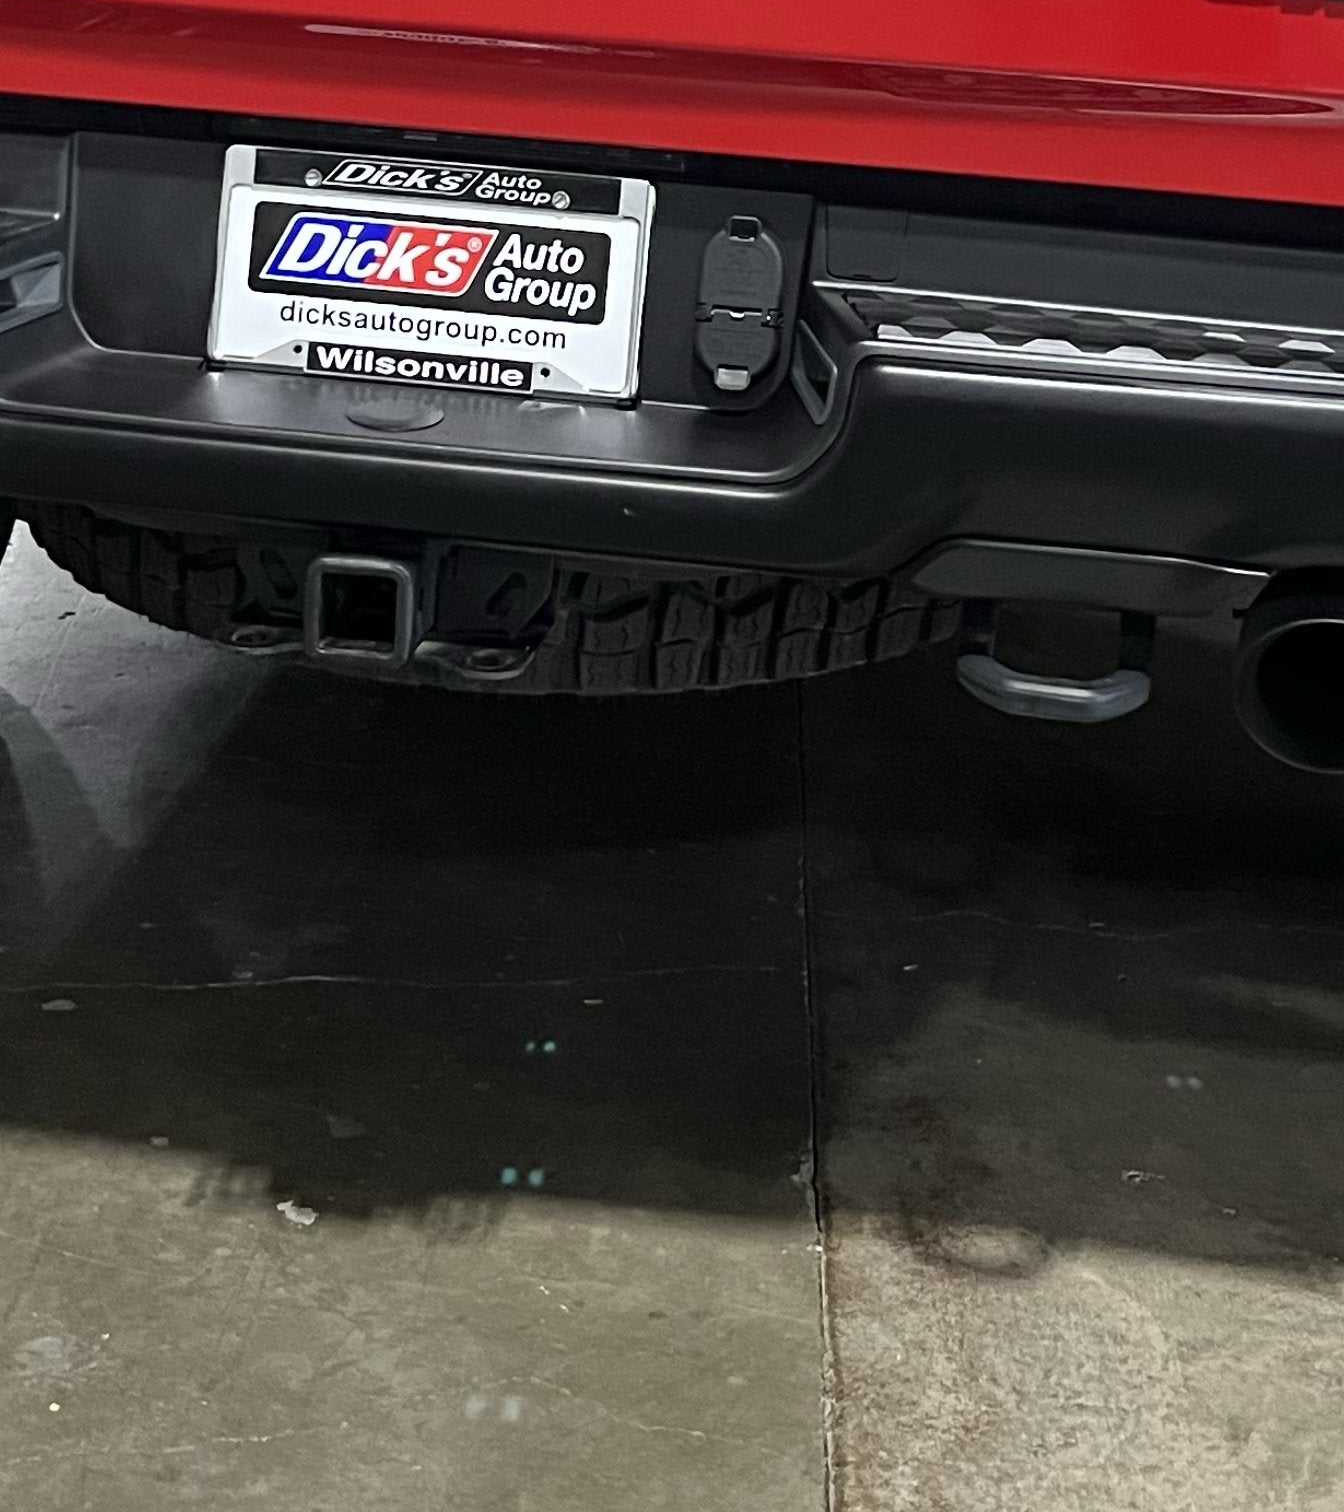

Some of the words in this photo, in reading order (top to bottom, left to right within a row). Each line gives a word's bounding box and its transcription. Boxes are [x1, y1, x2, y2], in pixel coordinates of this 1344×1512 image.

[333, 163, 464, 191] Dick's
[482, 172, 542, 190] Auto
[475, 184, 552, 206] Group
[277, 222, 470, 288] Dick's
[492, 233, 585, 274] Auto
[484, 267, 597, 317] Group
[280, 301, 566, 349] dicksautogroup.com
[316, 345, 524, 387] Wilsonville
